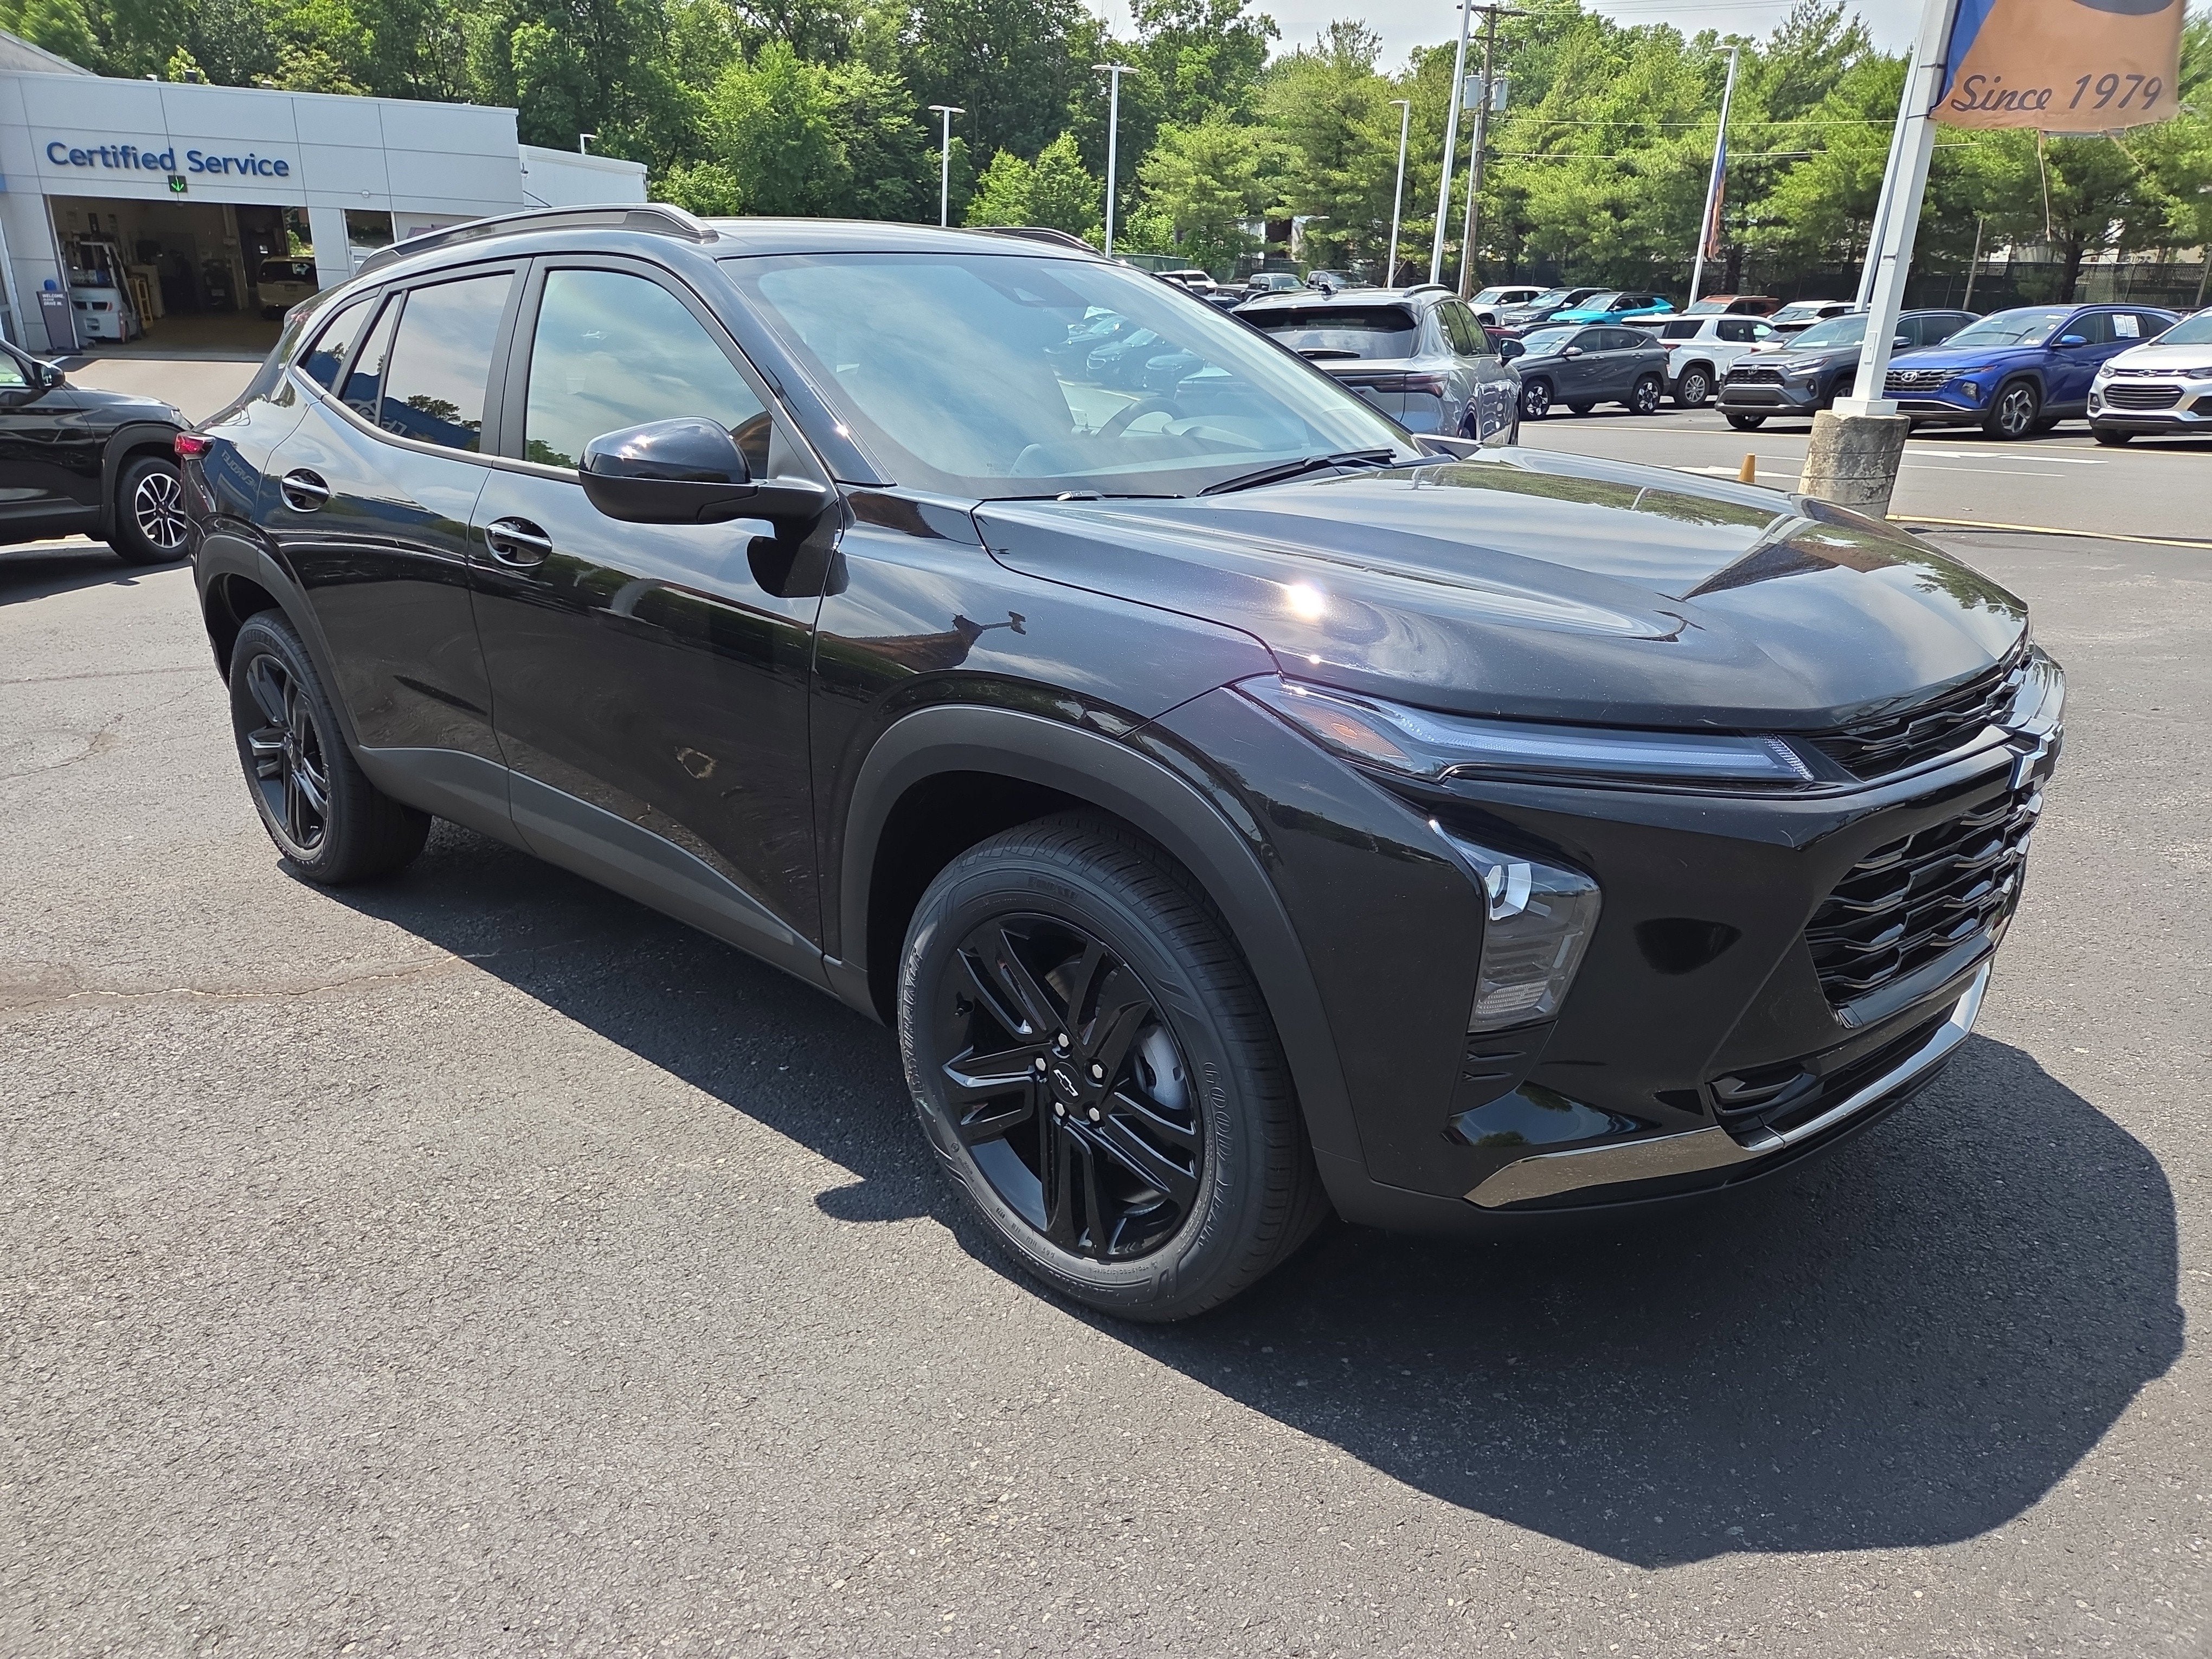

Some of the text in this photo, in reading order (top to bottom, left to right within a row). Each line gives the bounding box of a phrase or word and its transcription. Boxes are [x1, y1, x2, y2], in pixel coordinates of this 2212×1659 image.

[1951, 73, 2163, 112] Since 1979
[46, 141, 290, 177] Certified Service
